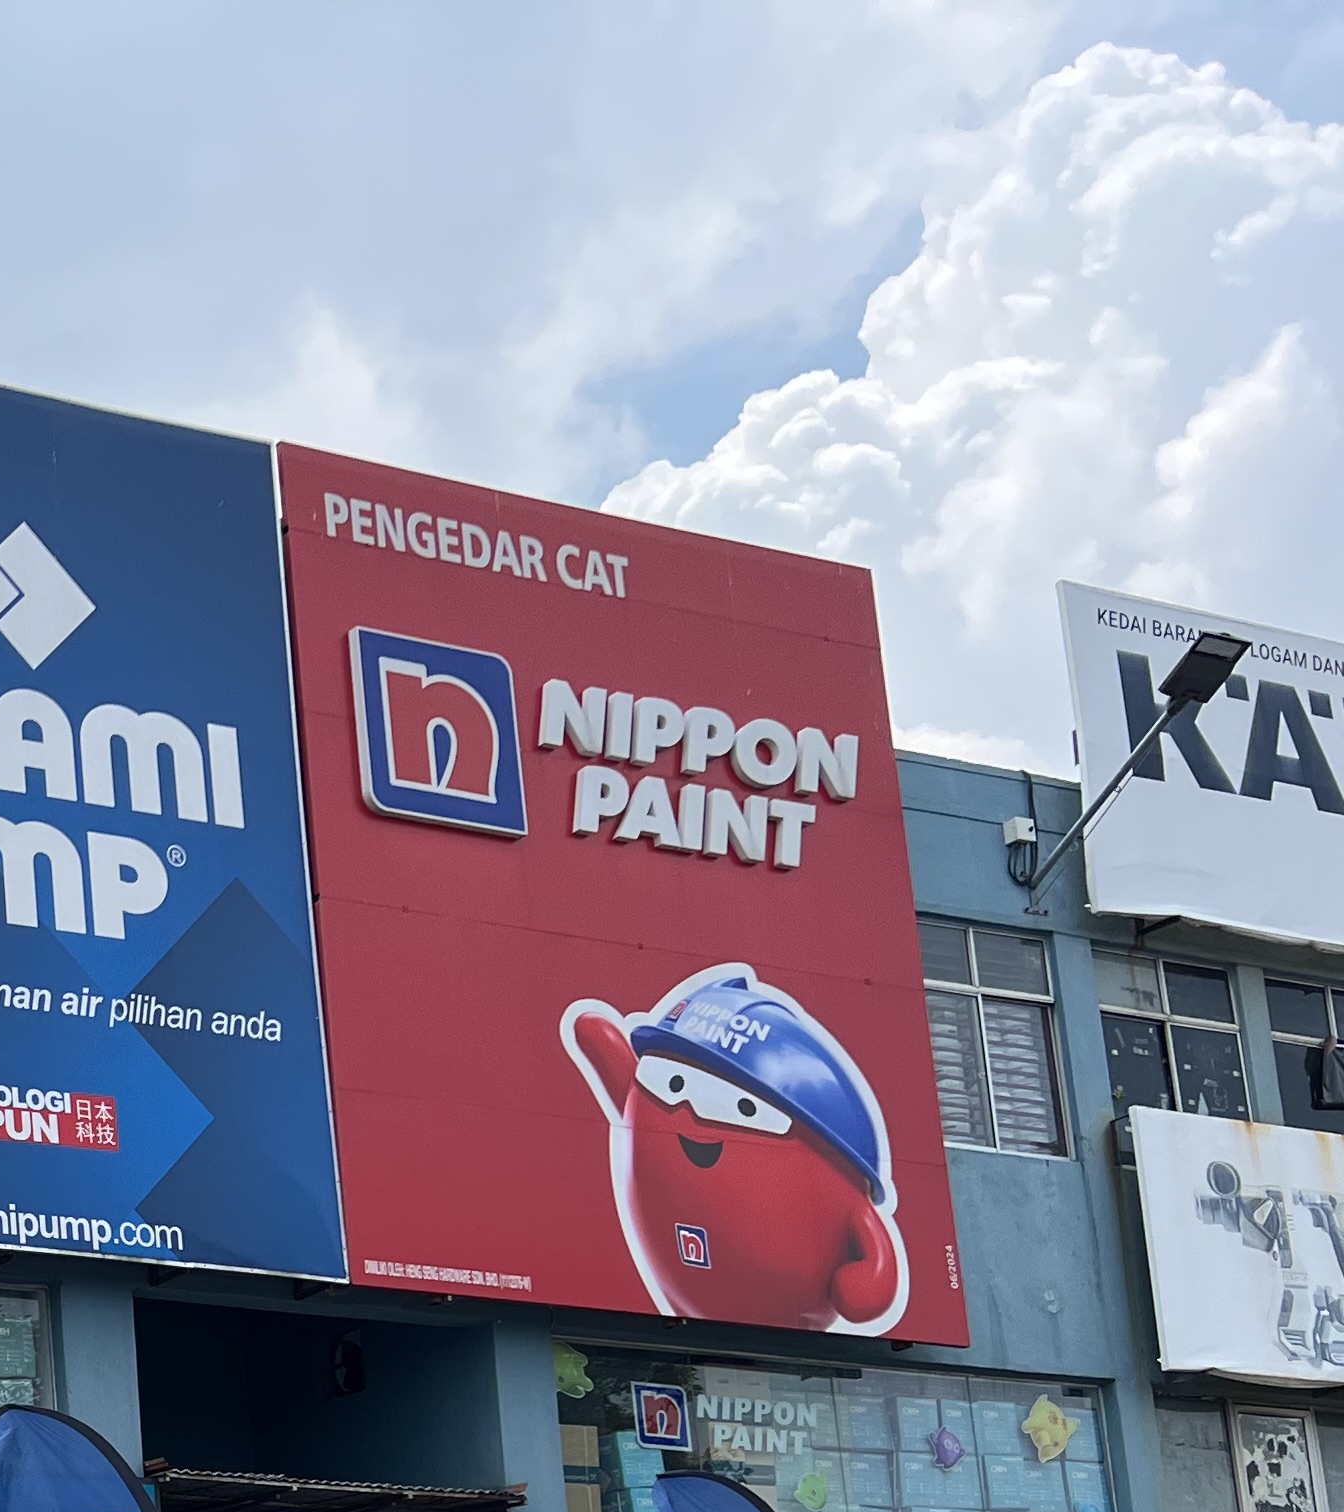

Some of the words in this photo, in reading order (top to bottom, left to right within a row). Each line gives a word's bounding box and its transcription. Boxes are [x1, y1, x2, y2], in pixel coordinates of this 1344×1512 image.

[324, 491, 547, 582] PENGEDAR
[555, 543, 629, 598] CAT
[1097, 608, 1146, 634] KEDAI
[1250, 643, 1307, 669] LOGAM
[537, 678, 859, 801] NIPPON
[572, 764, 817, 871] PAINT
[60, 985, 103, 1019] air
[110, 992, 204, 1033] pilihan
[212, 1007, 282, 1043] anda
[691, 1001, 771, 1041] NIPPON
[685, 1016, 750, 1054] PAINT
[74, 1098, 115, 1123] 日本
[75, 1121, 116, 1146] 科技
[696, 1394, 817, 1427] NIPPON
[714, 1425, 808, 1455] PAINT
